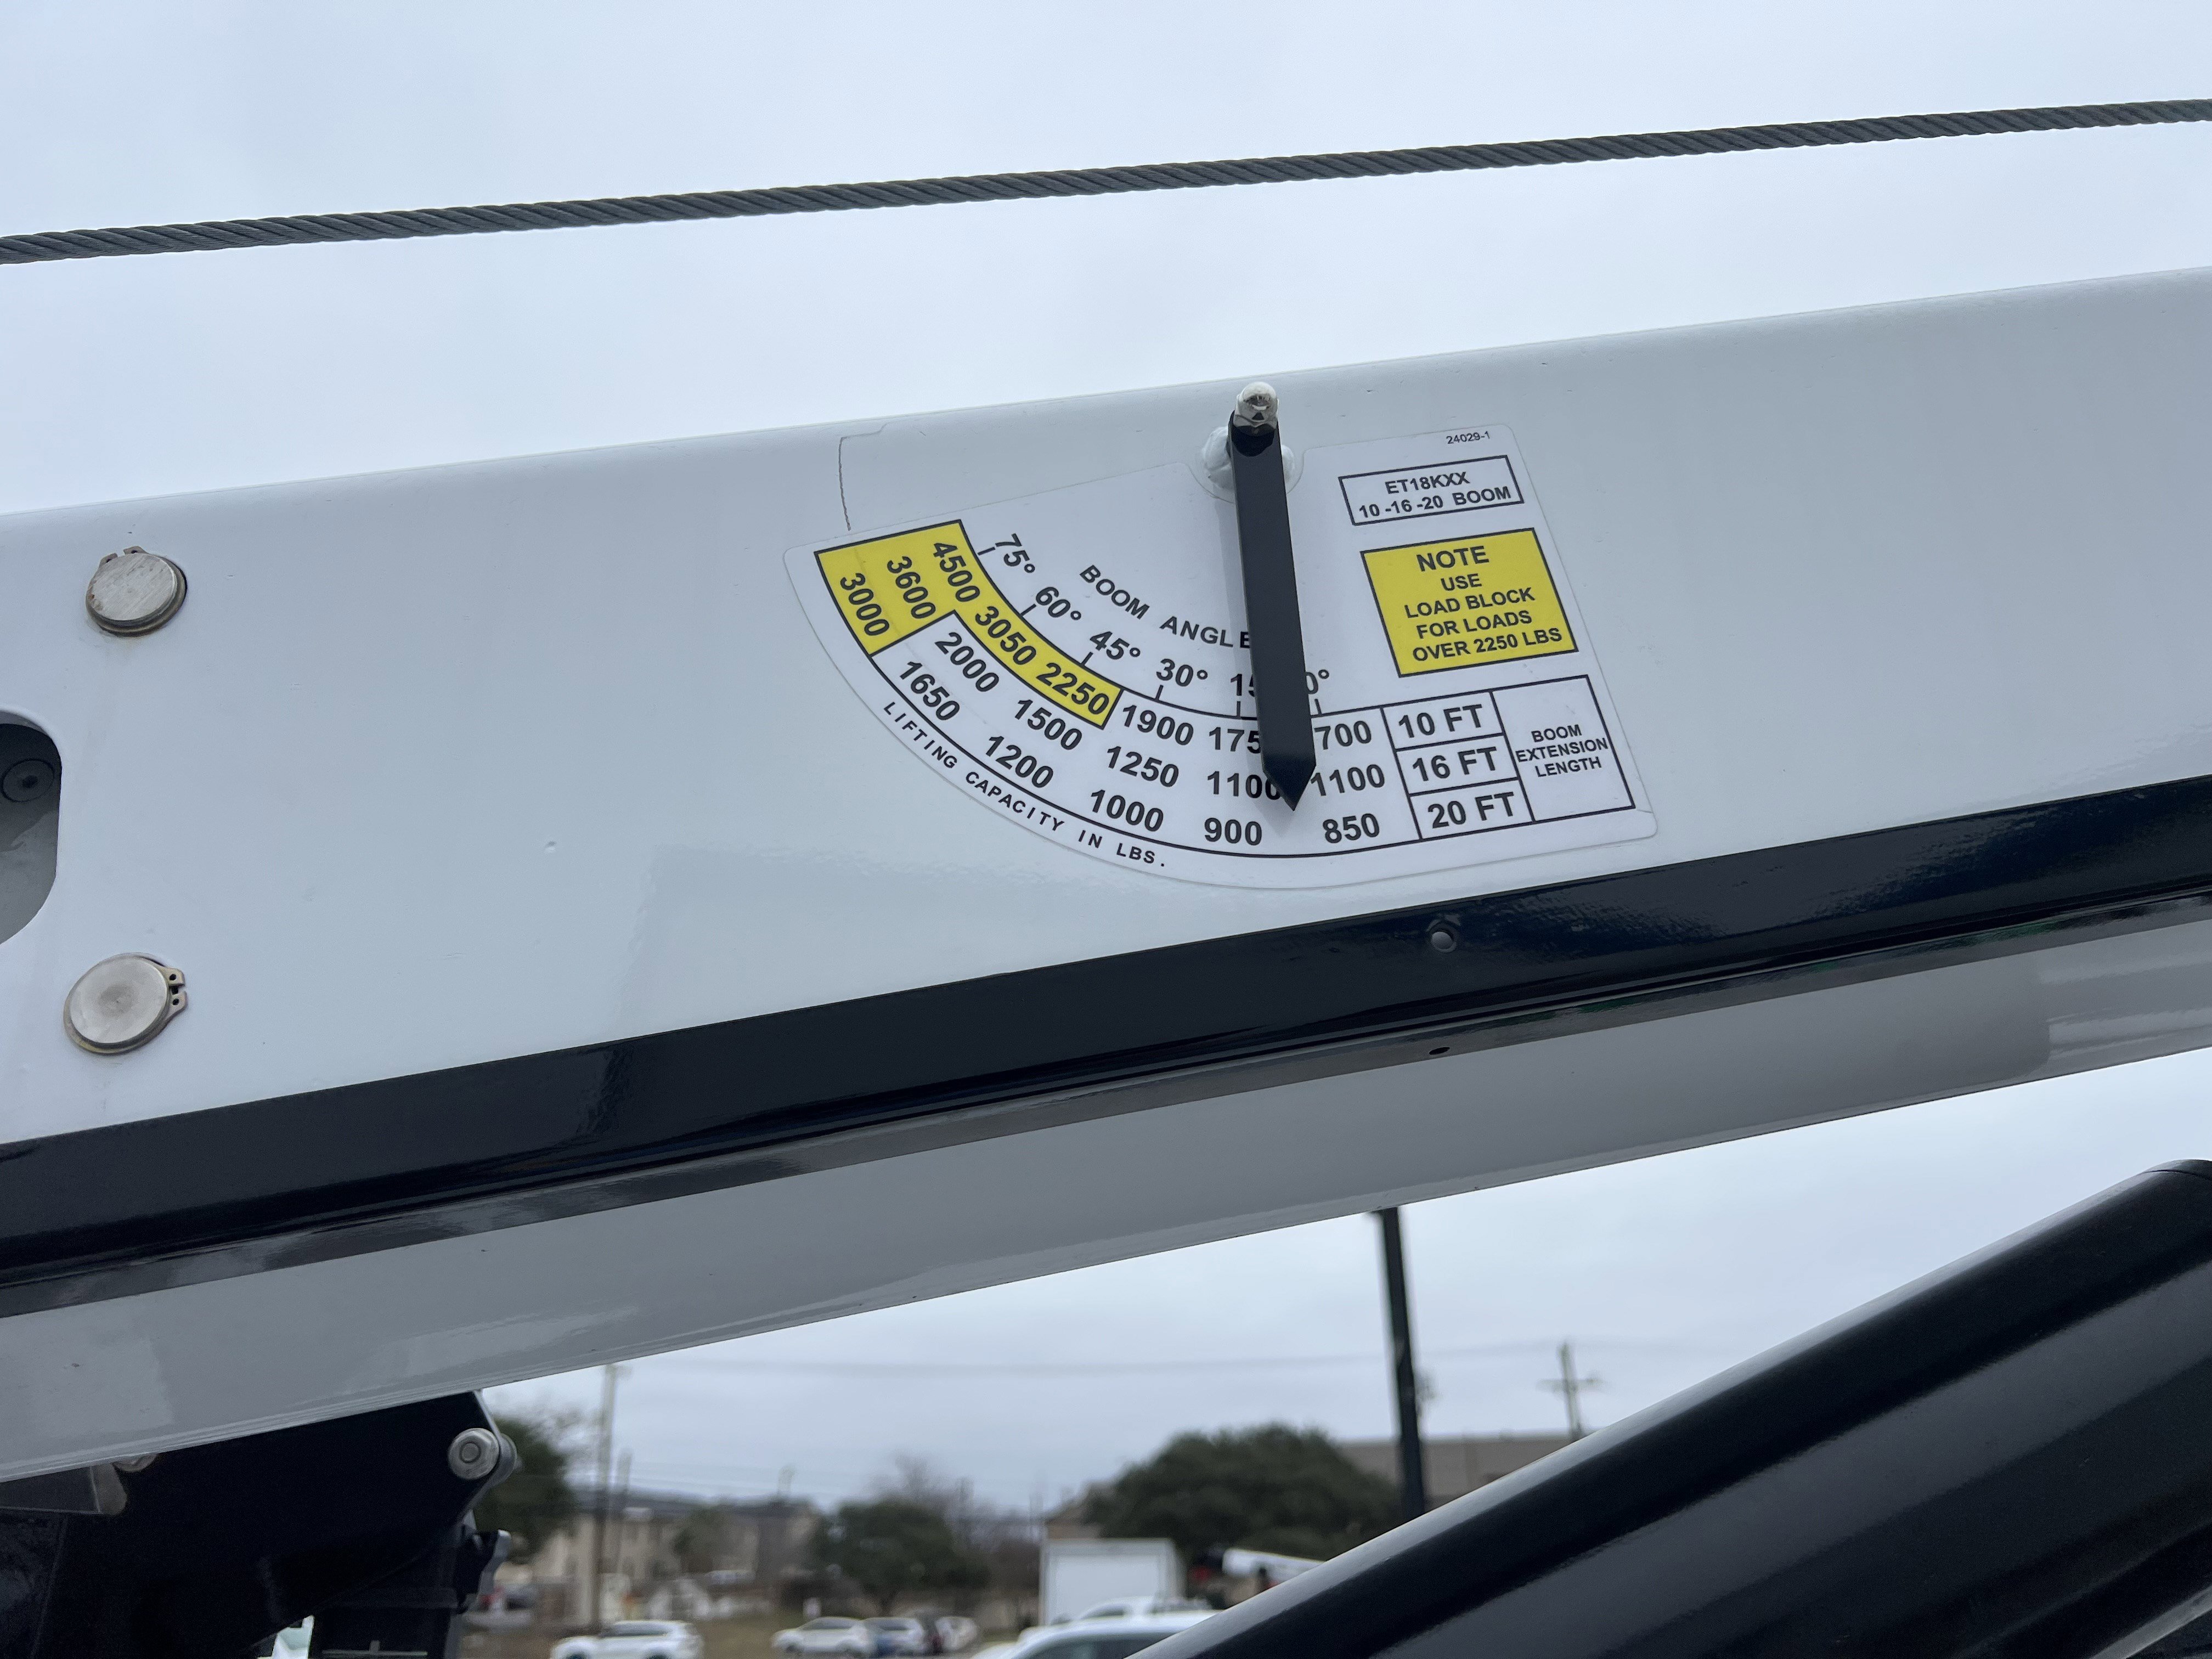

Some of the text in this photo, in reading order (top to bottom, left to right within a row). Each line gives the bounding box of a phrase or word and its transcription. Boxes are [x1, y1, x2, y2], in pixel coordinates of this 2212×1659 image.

[1446, 431, 1490, 444] 24029-1
[1384, 471, 1470, 494] ET18KXX
[1451, 486, 1511, 506] BOOM
[1416, 545, 1489, 572] NOTE
[1440, 573, 1482, 591] USE
[995, 533, 1035, 574] 75°
[1035, 586, 1082, 620] 60°
[1089, 631, 1141, 660] 45°
[1156, 658, 1208, 687] 30°
[1079, 565, 1251, 649] BOOM ANGLE
[1404, 586, 1536, 619] LOAD BLOCK
[1415, 610, 1532, 639] FOR LOADS
[933, 542, 1483, 754] 4500 3050 2250 1900 175 700 10 FT
[1412, 628, 1562, 662] OVER 2250 LBS
[887, 556, 1497, 800] 3600 2000 1500 1250 1100 1100 16 FT
[839, 573, 1515, 846] 3000 1650 1200 1000 900 850 20 FT
[1531, 724, 1582, 743] BOOM
[1515, 737, 1609, 763] EXTENSION
[1534, 756, 1602, 778] LENGTH
[883, 701, 1165, 867] LIFTING CAPACITY IN LBS.
